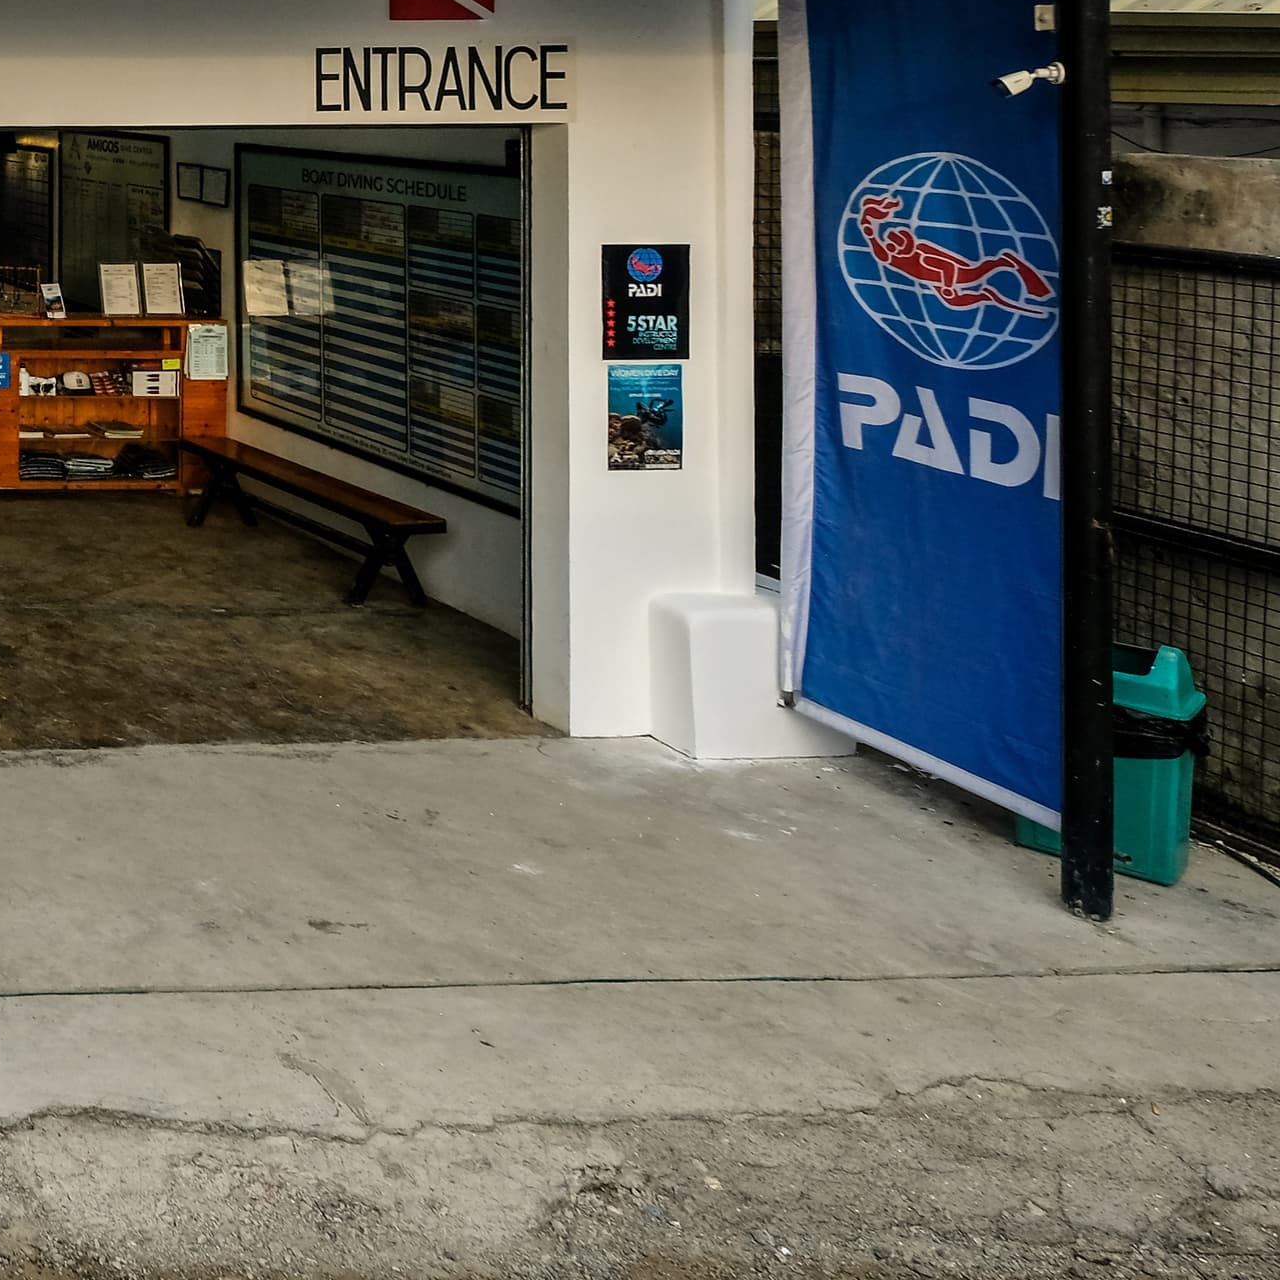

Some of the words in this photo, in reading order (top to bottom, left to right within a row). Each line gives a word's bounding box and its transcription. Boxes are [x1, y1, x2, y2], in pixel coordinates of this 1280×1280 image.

[316, 45, 568, 111] ENTRANCE
[301, 167, 334, 187] BOAT
[336, 171, 383, 193] DIVING
[386, 177, 467, 203] SCHEDULE
[628, 283, 663, 297] PADI
[626, 315, 636, 331] 5
[637, 315, 678, 331] STAR
[836, 371, 1061, 501] PADI
